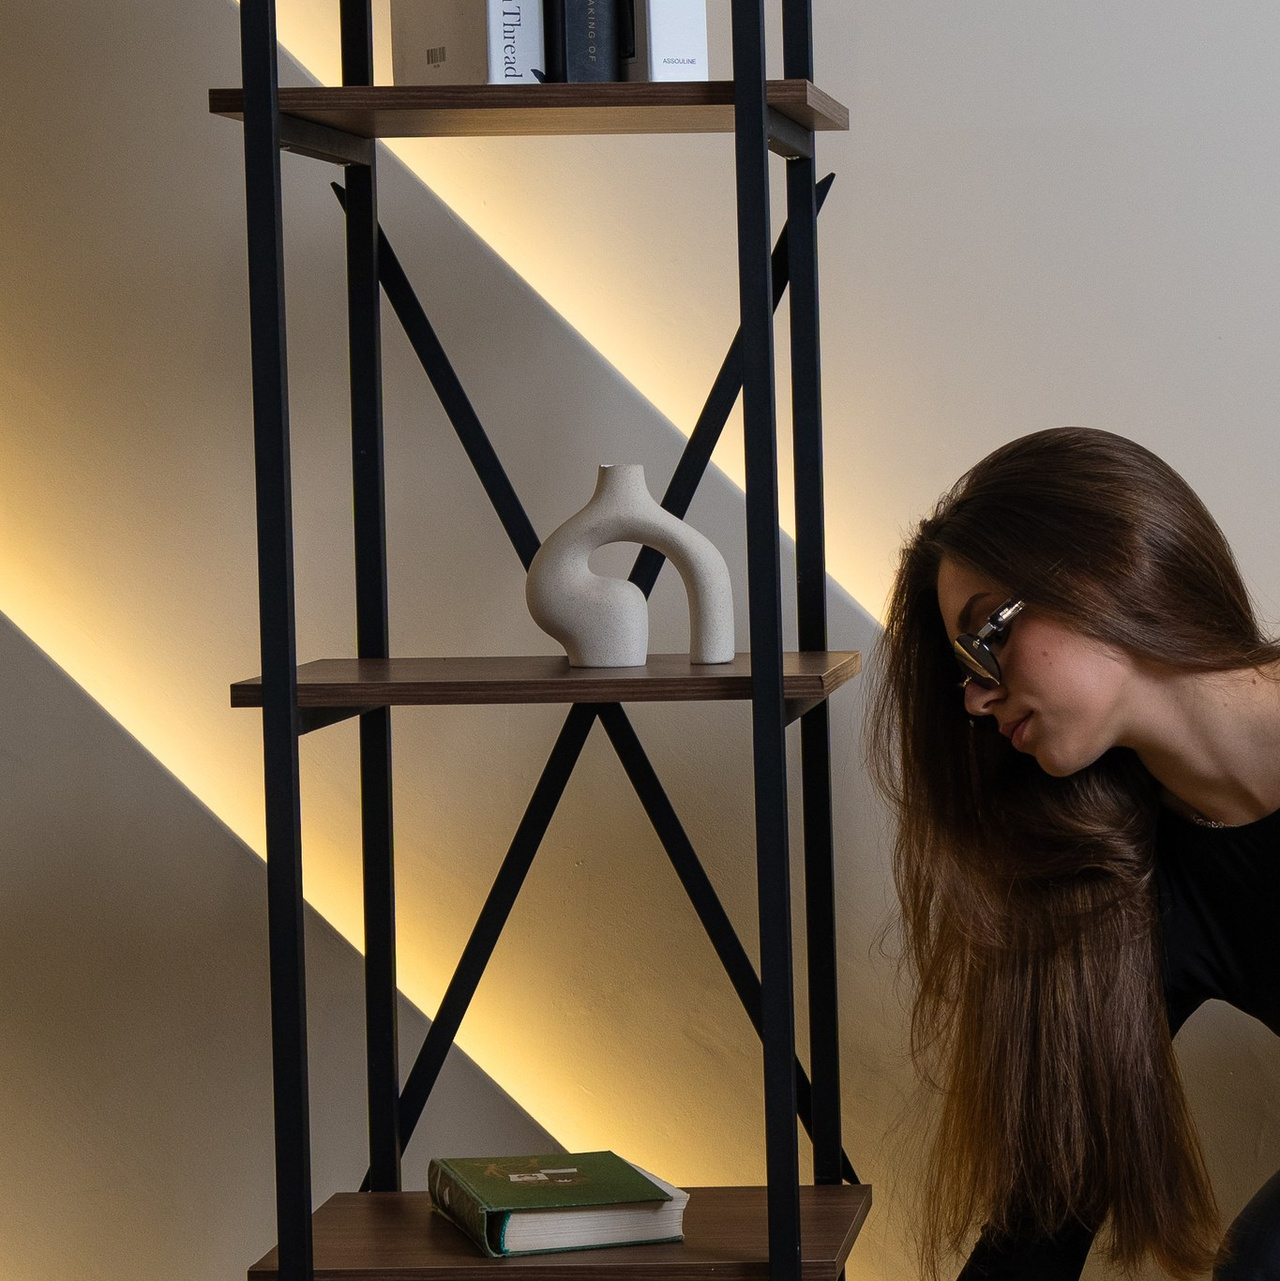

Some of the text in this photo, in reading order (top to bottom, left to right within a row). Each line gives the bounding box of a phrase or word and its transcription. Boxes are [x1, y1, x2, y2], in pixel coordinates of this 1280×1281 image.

[502, 5, 523, 79] Thread
[588, 45, 597, 62] OF
[662, 57, 697, 65] ASSOULINE
